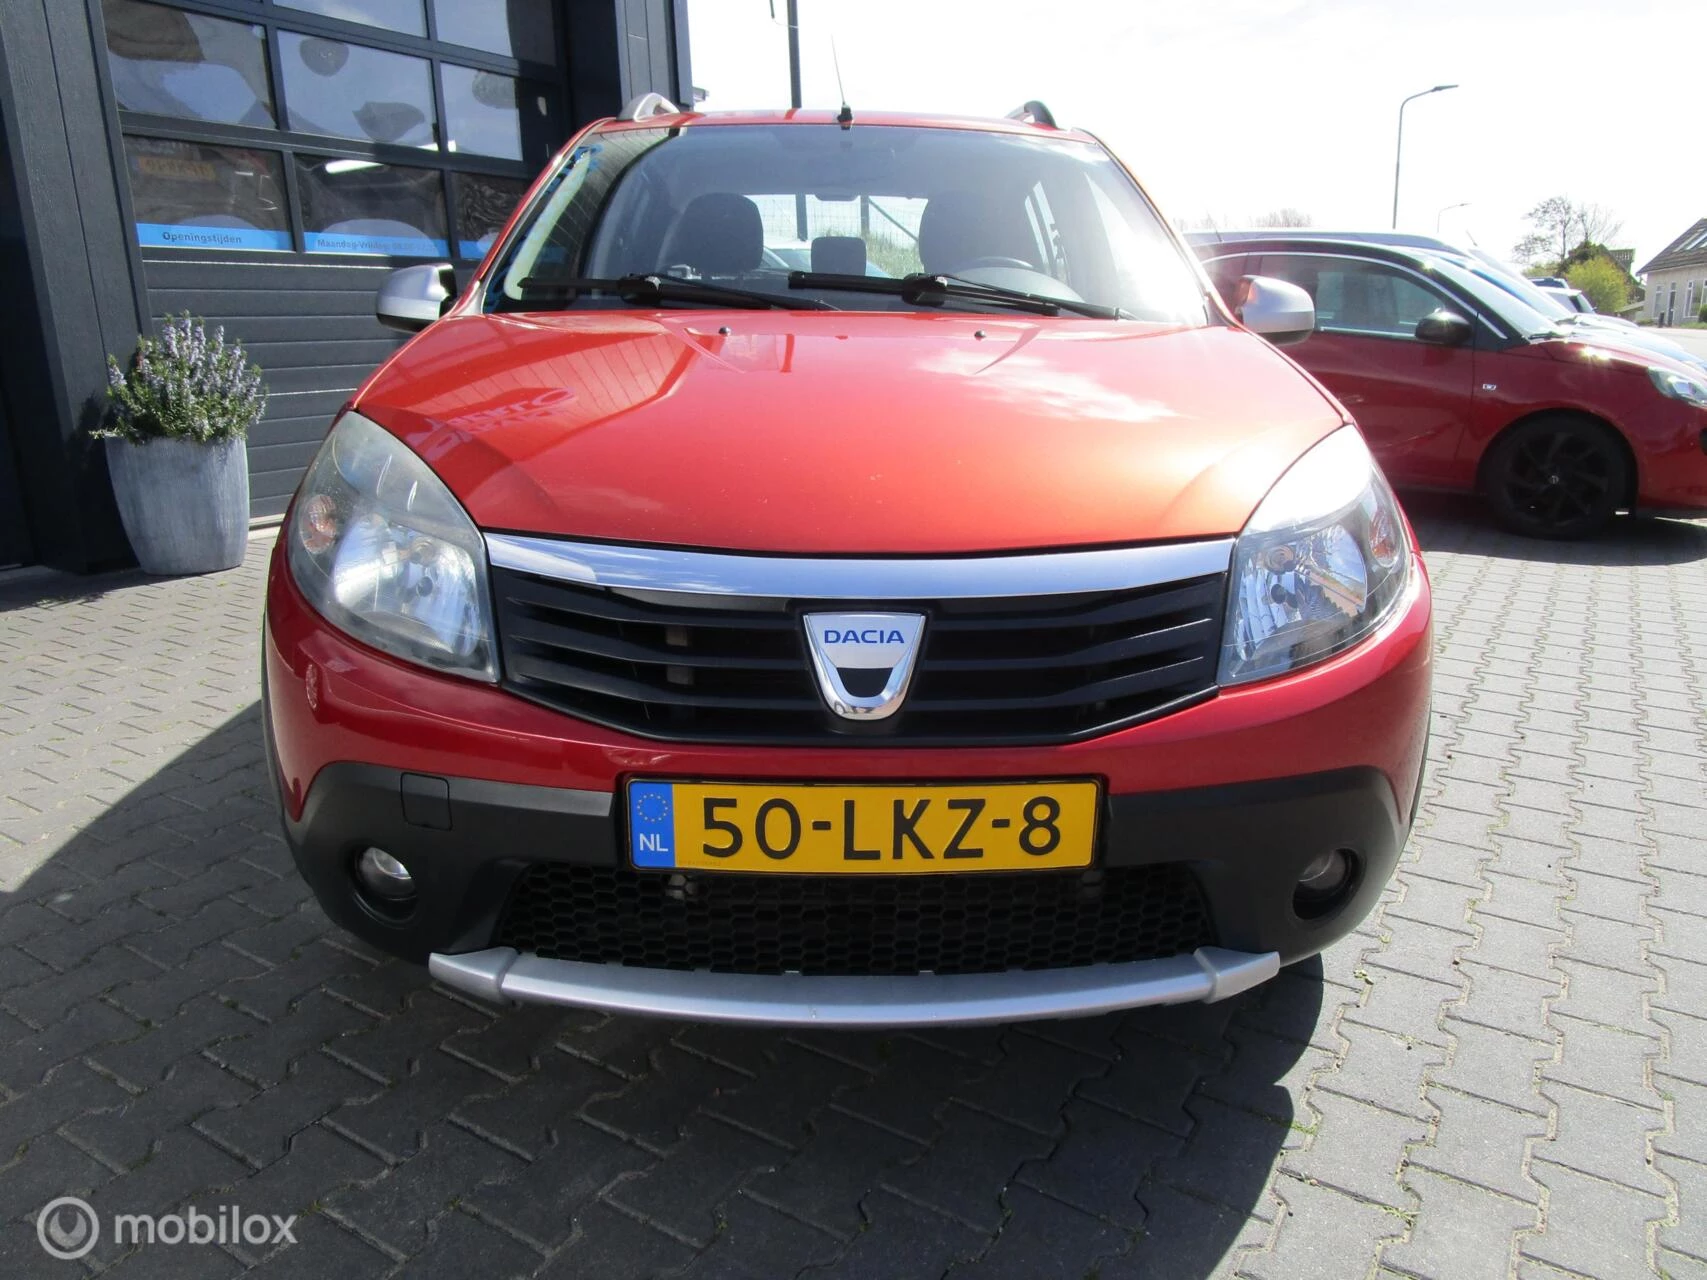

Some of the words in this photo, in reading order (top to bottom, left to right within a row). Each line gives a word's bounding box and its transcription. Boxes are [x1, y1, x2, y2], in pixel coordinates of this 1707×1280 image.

[162, 231, 242, 245] Openingstijden
[824, 629, 905, 645] DACIA
[702, 796, 1061, 861] 50-LKZ-8
[639, 832, 668, 852] NL
